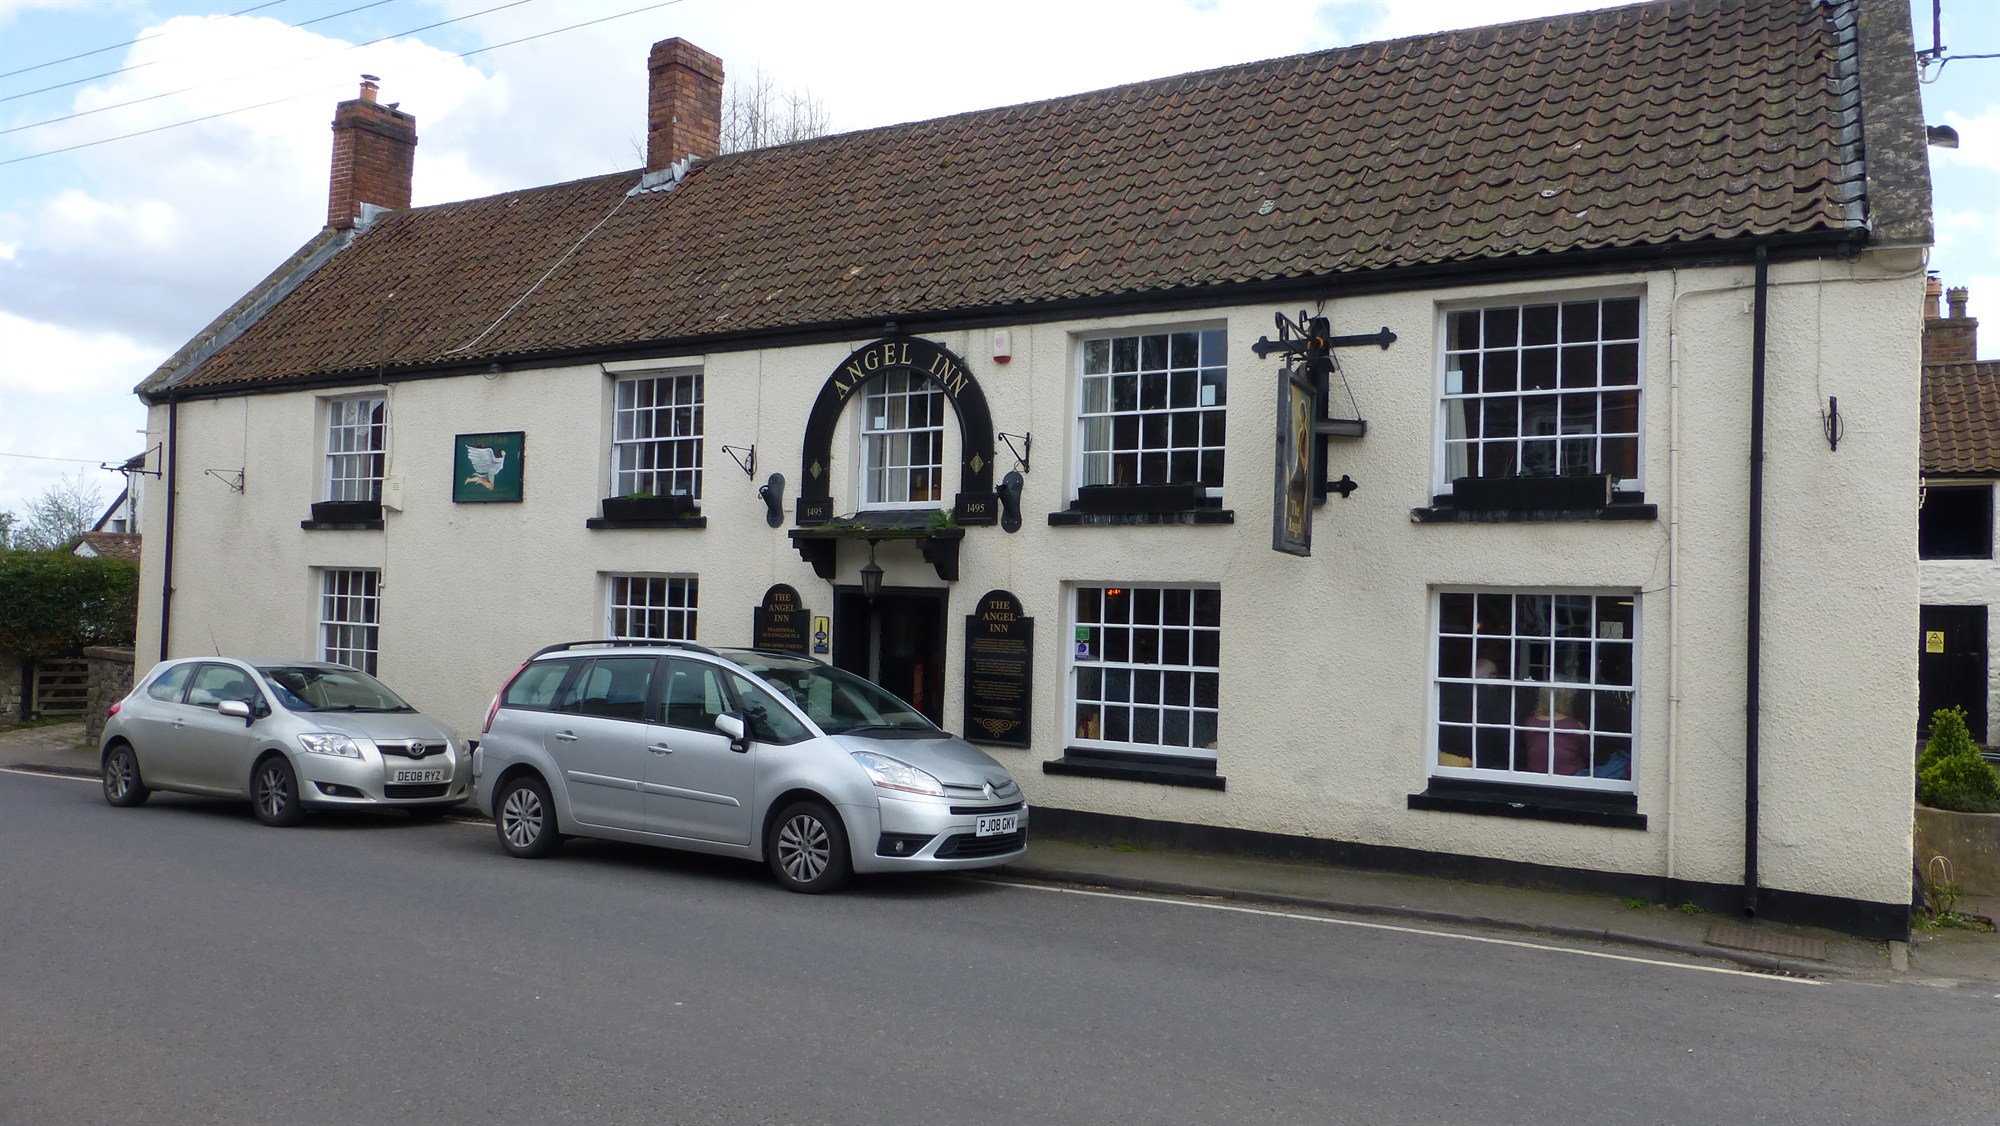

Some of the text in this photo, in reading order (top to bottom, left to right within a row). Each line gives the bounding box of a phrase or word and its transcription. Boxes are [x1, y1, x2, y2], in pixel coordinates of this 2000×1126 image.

[833, 342, 970, 400] ANGEL INN
[806, 507, 823, 517] 1495
[966, 503, 985, 513] 1495
[1291, 500, 1301, 516] The
[1288, 517, 1302, 538] Angel
[774, 594, 790, 602] THE
[768, 604, 796, 612] ANGEL
[989, 600, 1010, 610] THE
[774, 614, 790, 623] INN
[982, 612, 1016, 621] ANGEL
[989, 623, 1009, 633] INN
[397, 771, 440, 781] DE08 RYZ
[980, 819, 1001, 832] PJ08
